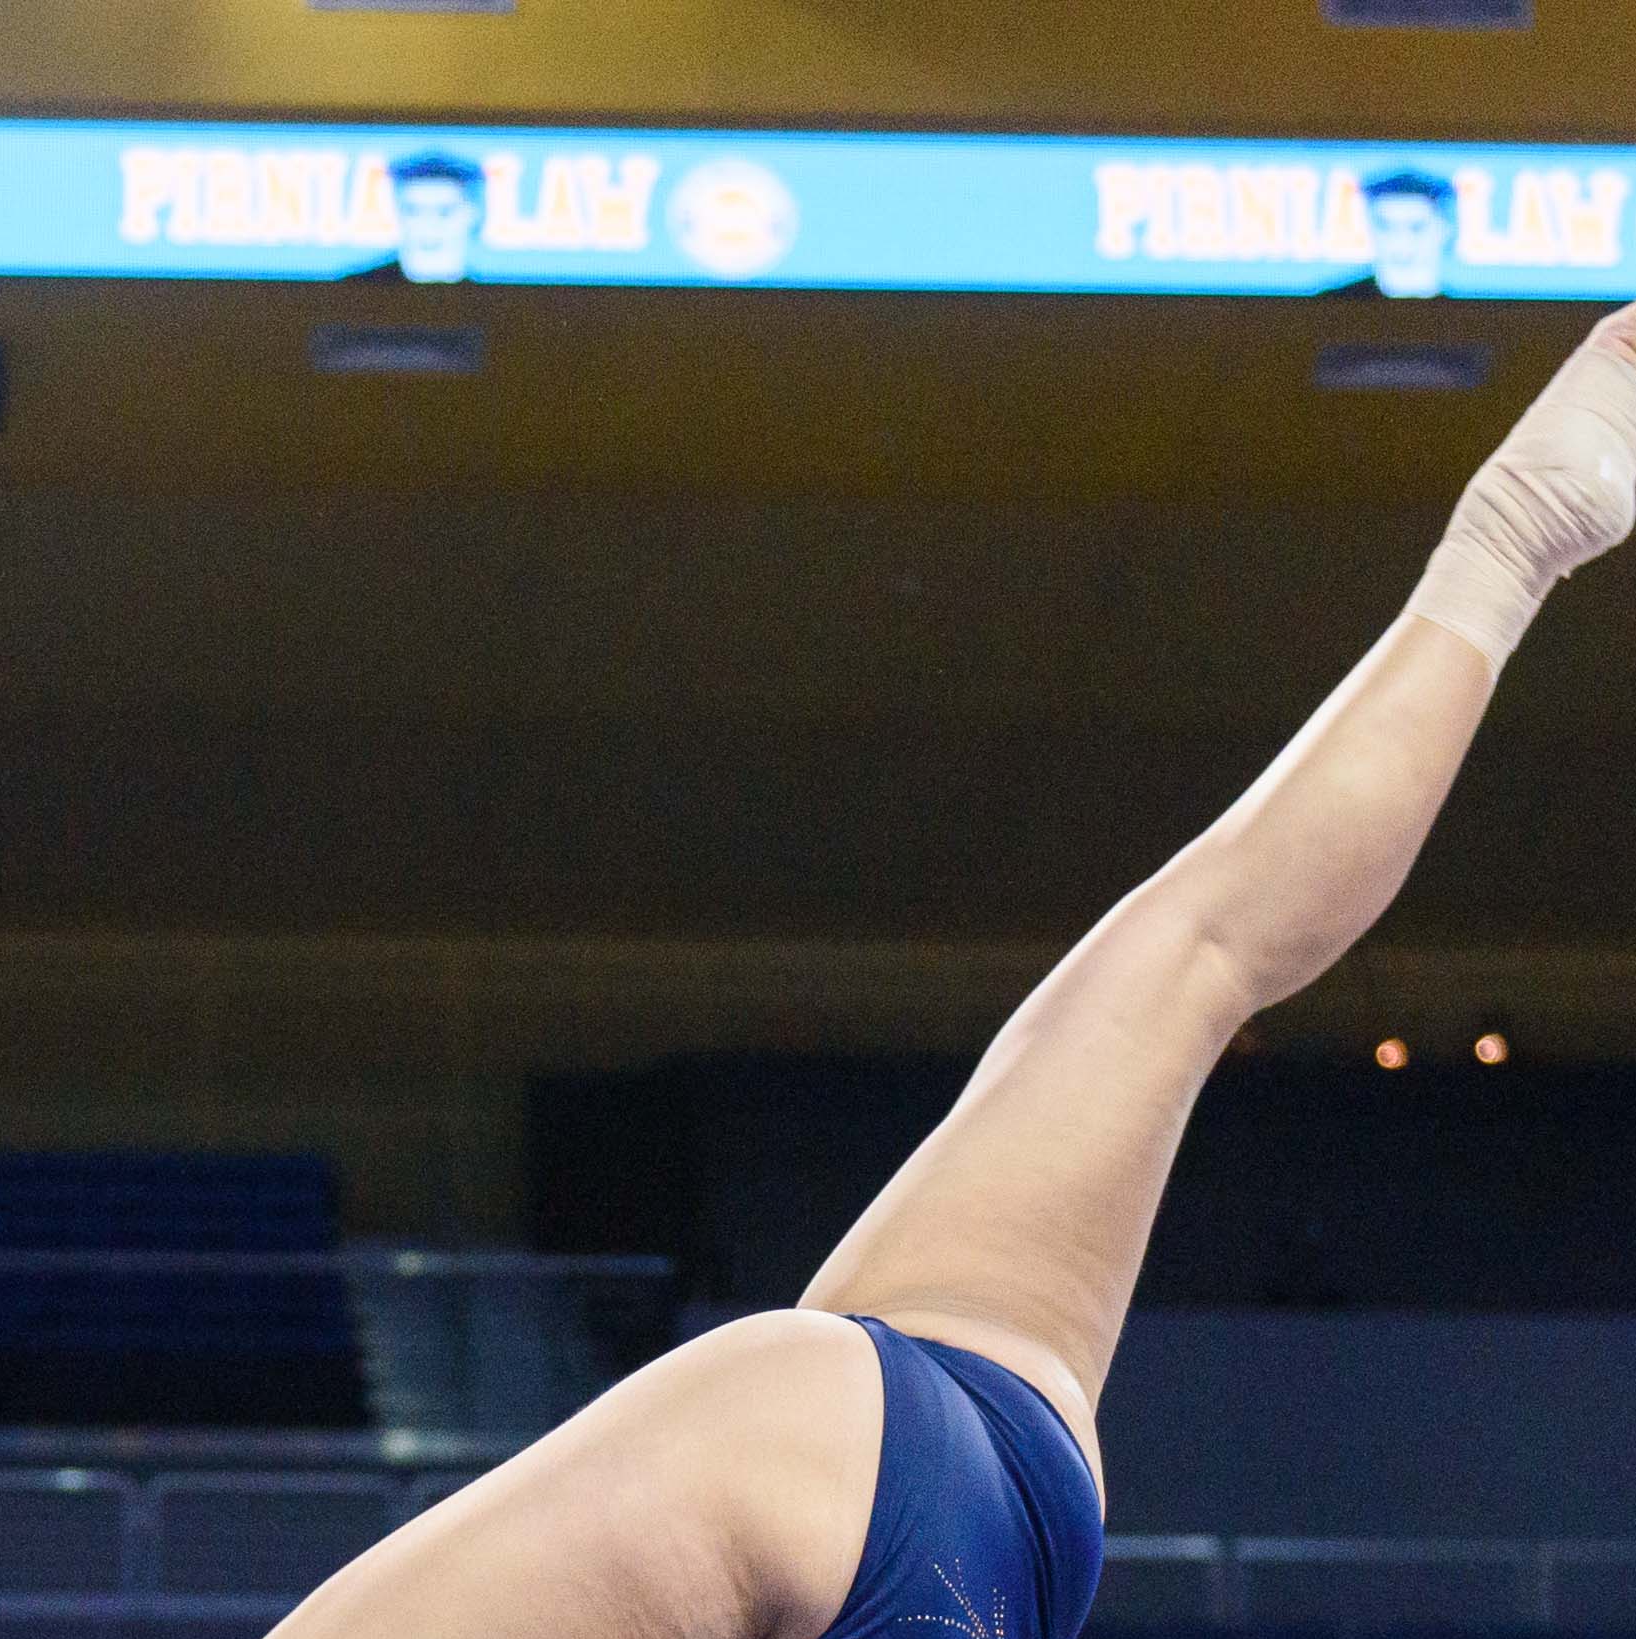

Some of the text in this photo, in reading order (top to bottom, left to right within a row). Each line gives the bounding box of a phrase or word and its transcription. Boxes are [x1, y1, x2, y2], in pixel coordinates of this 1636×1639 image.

[119, 147, 660, 250] PIRNIA LAW
[1093, 163, 1628, 268] PIRNIA LAW
